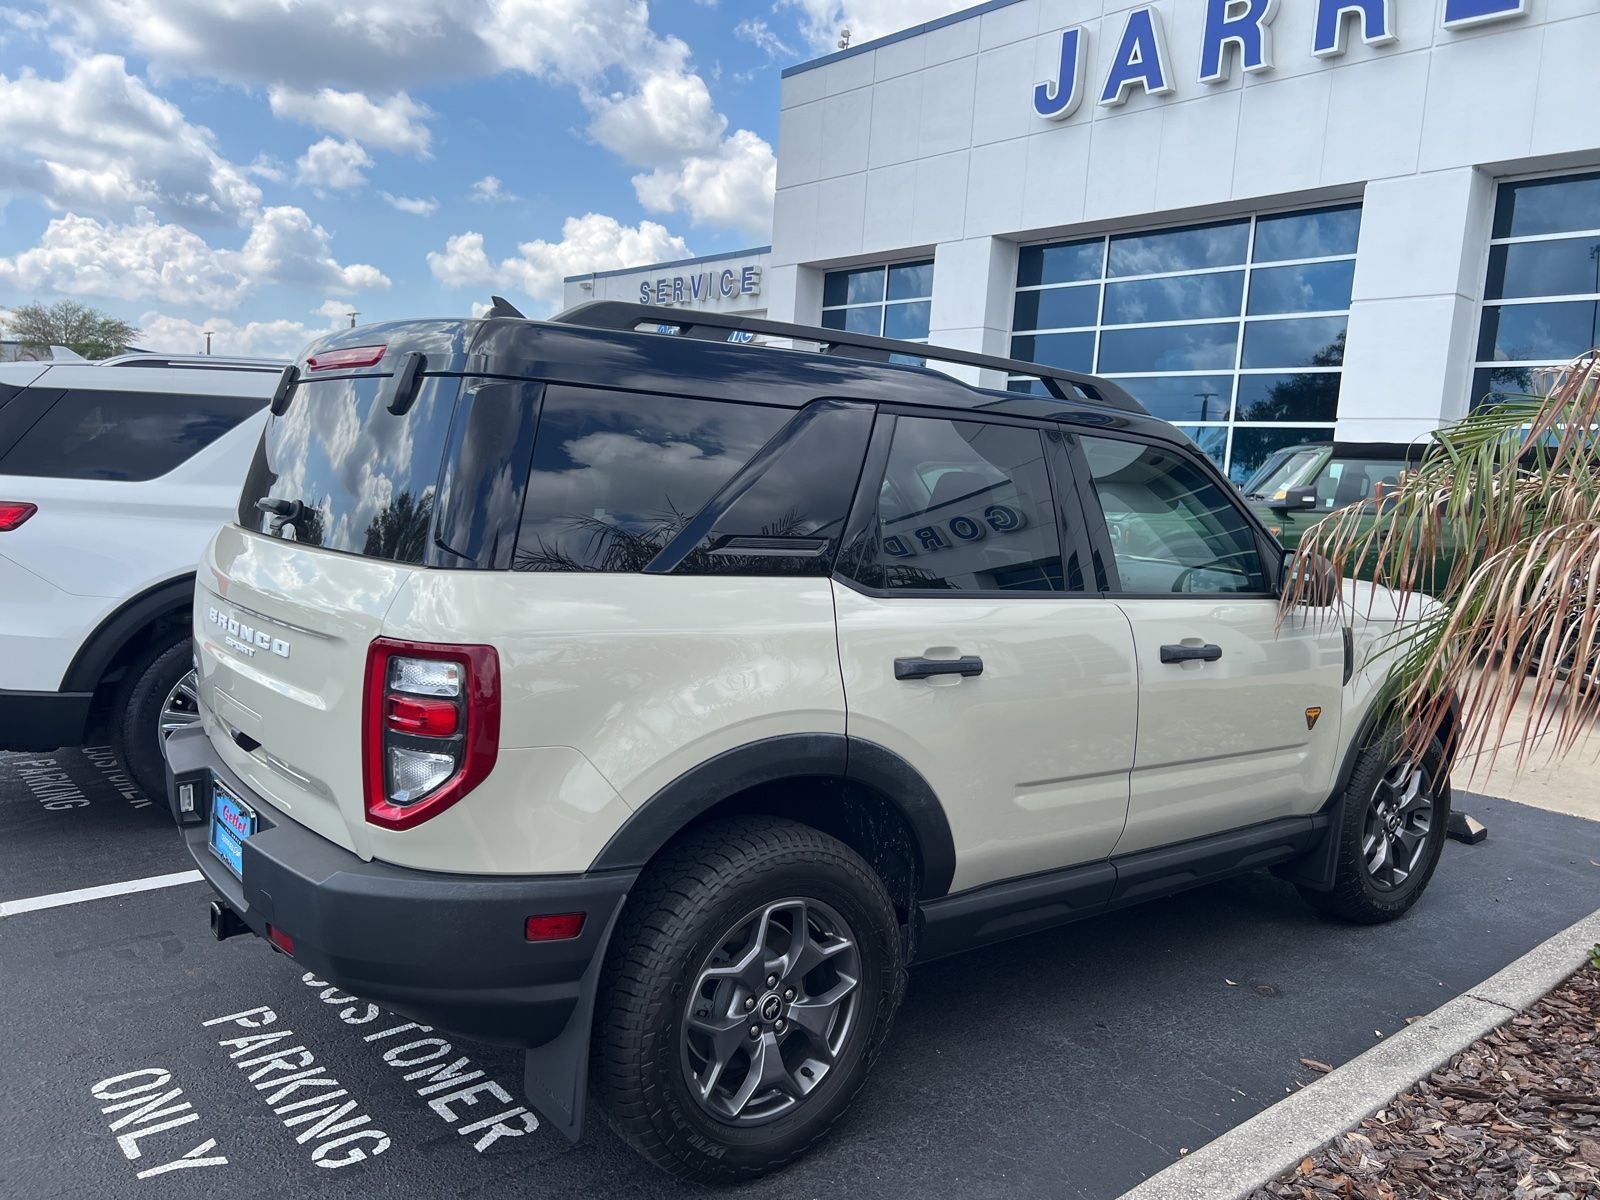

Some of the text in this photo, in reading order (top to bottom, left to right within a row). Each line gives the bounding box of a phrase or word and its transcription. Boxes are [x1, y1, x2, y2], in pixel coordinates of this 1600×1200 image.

[1031, 0, 1529, 121] JARR
[639, 265, 762, 306] SERVICE
[208, 607, 290, 659] BRONCO
[225, 636, 256, 657] SPORT
[12, 758, 91, 810] PARKING
[201, 1005, 391, 1169] PARKING
[91, 1067, 228, 1180] ONLY
